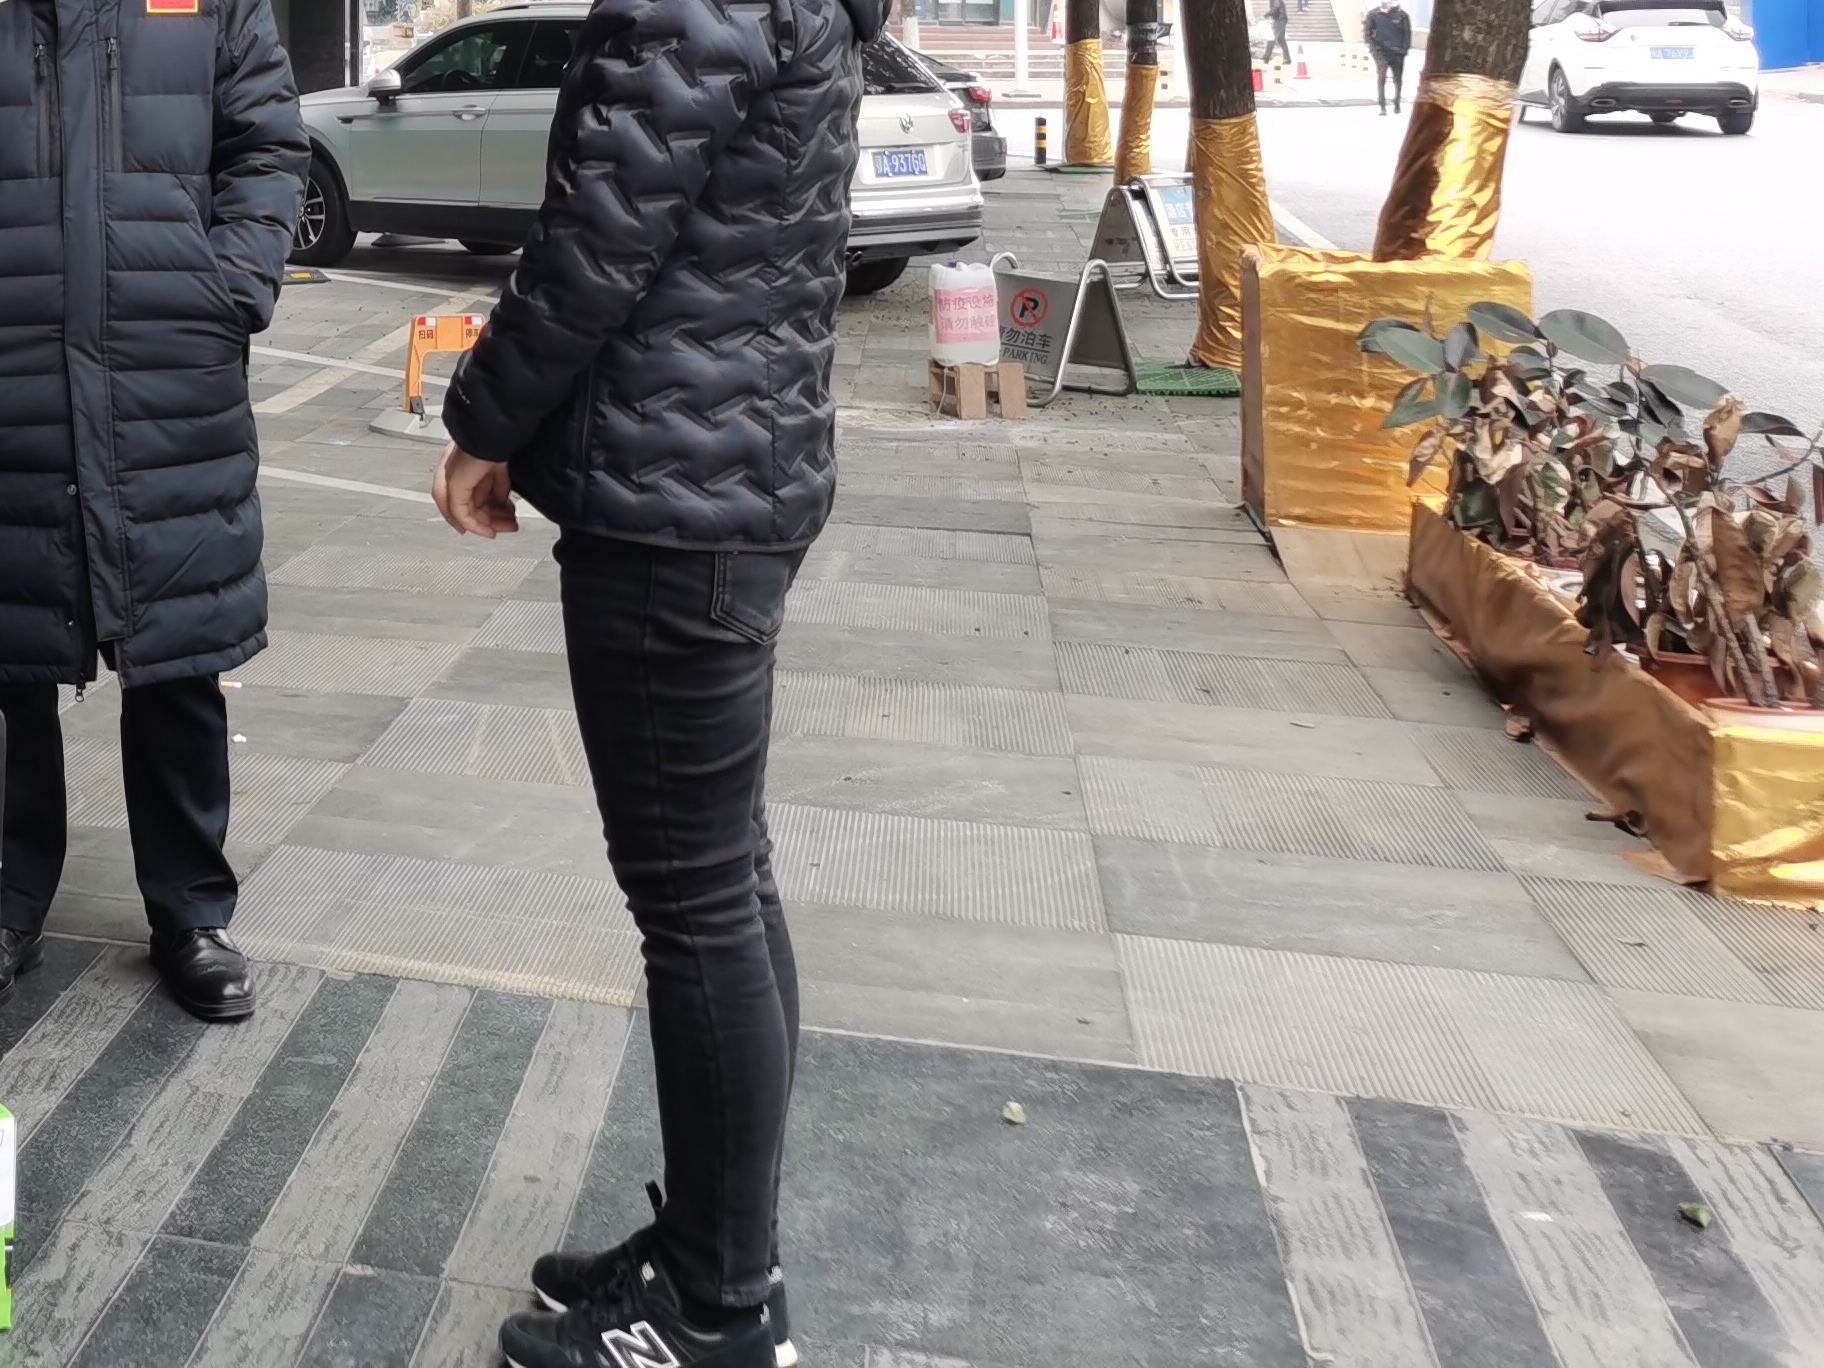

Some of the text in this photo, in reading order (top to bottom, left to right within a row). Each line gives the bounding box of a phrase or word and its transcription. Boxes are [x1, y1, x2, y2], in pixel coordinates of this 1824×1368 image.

[938, 294, 995, 312] 防疫设施
[1002, 346, 1049, 365] PARKING
